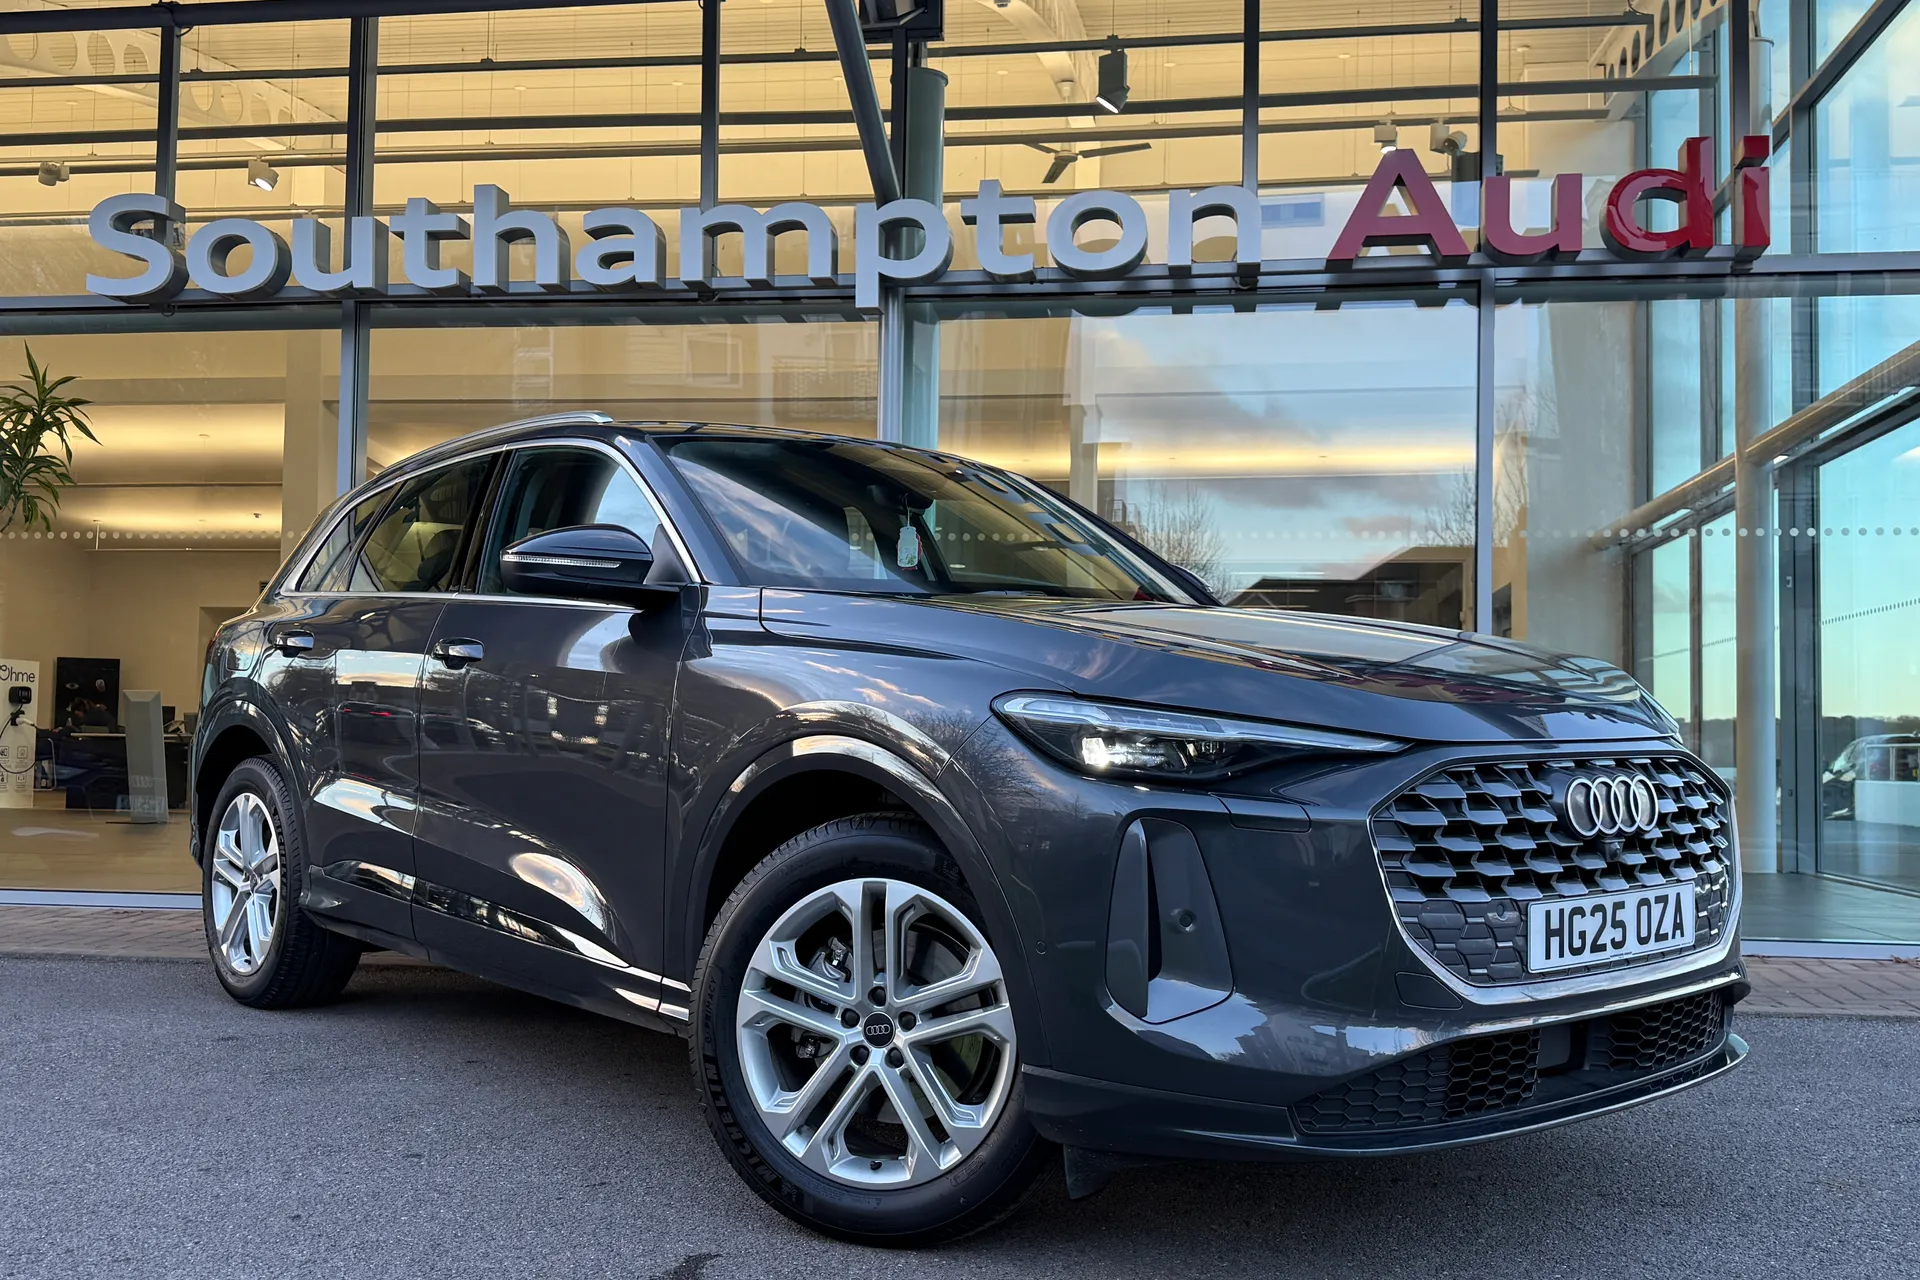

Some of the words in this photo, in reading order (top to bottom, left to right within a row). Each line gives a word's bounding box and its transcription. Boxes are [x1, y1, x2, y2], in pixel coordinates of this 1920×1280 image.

[86, 179, 1261, 313] Southampton
[1326, 135, 1770, 267] Audi
[1544, 900, 1627, 960] HG25
[1636, 892, 1685, 946] OZA
[706, 1062, 777, 1184] MICHELIN
